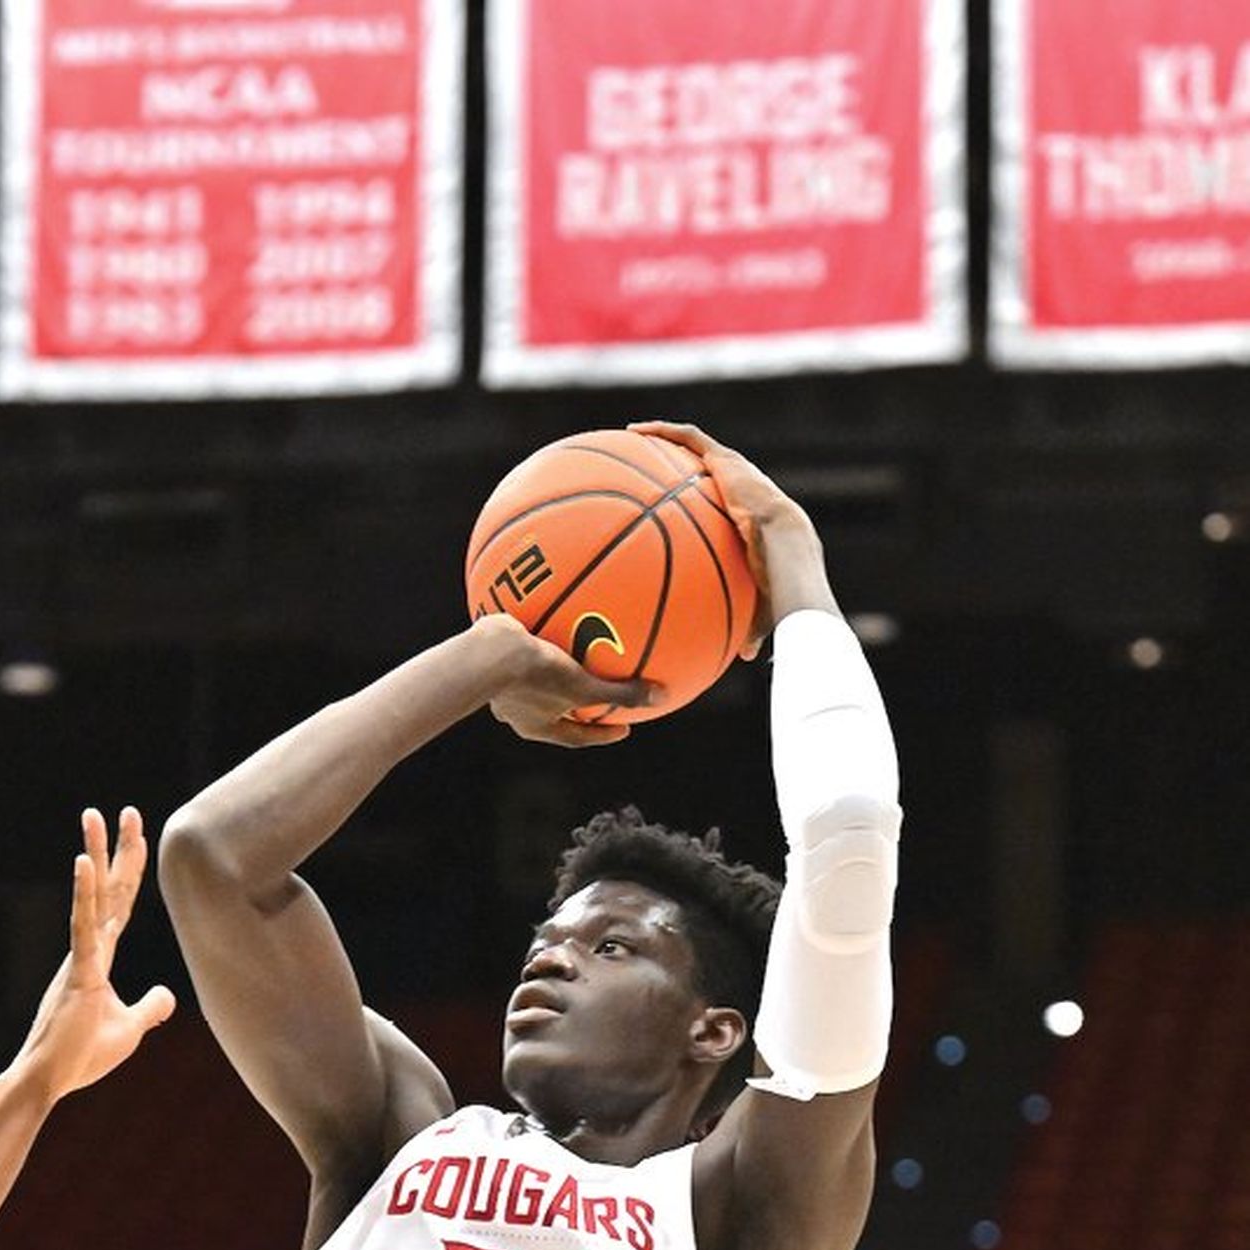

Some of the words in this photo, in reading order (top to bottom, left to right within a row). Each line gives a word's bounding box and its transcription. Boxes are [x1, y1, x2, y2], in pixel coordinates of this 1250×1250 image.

[141, 64, 318, 118] NCAA
[587, 54, 858, 147] GEORGE
[51, 113, 408, 174] TOURNAMENT
[558, 137, 891, 239] RAVELING
